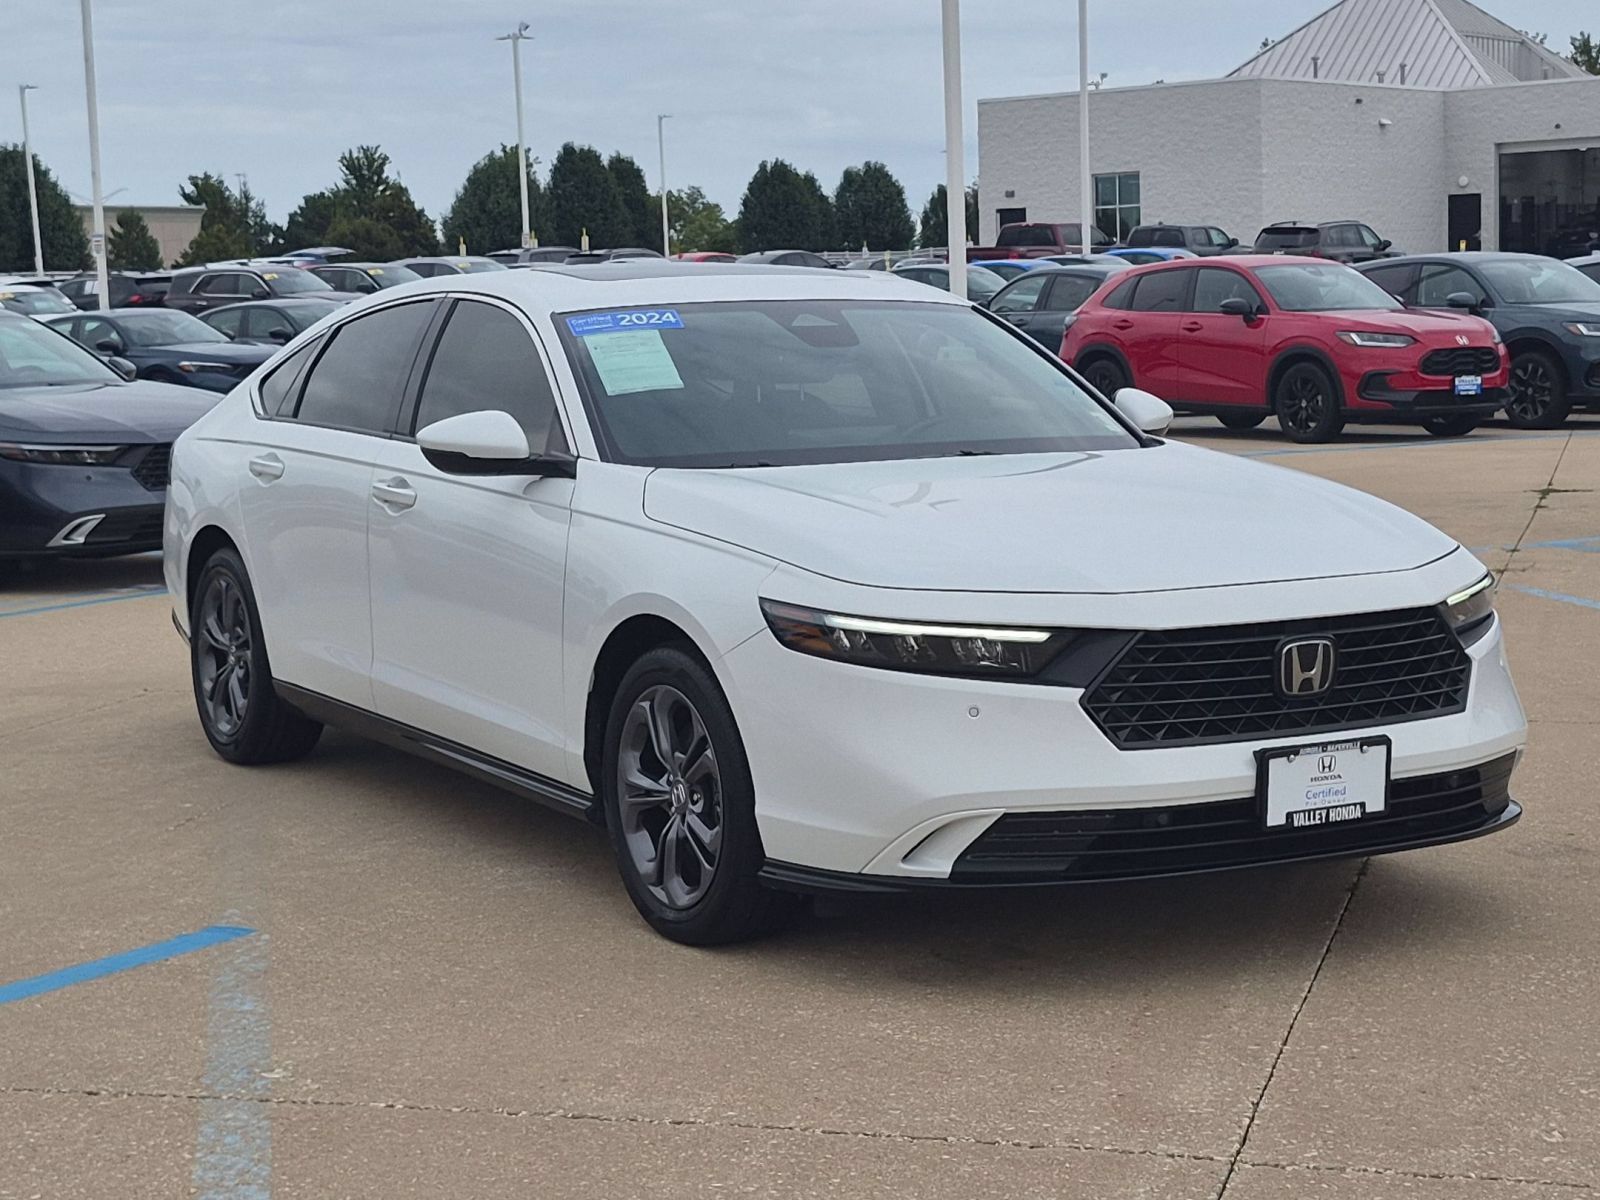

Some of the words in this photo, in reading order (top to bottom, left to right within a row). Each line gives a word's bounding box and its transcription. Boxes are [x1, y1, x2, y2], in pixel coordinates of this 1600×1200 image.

[616, 312, 677, 326] 2024
[1310, 774, 1342, 783] HONDA
[1305, 786, 1347, 800] Certified
[1293, 809, 1327, 827] VALLEY
[1329, 804, 1362, 822] HONDA
